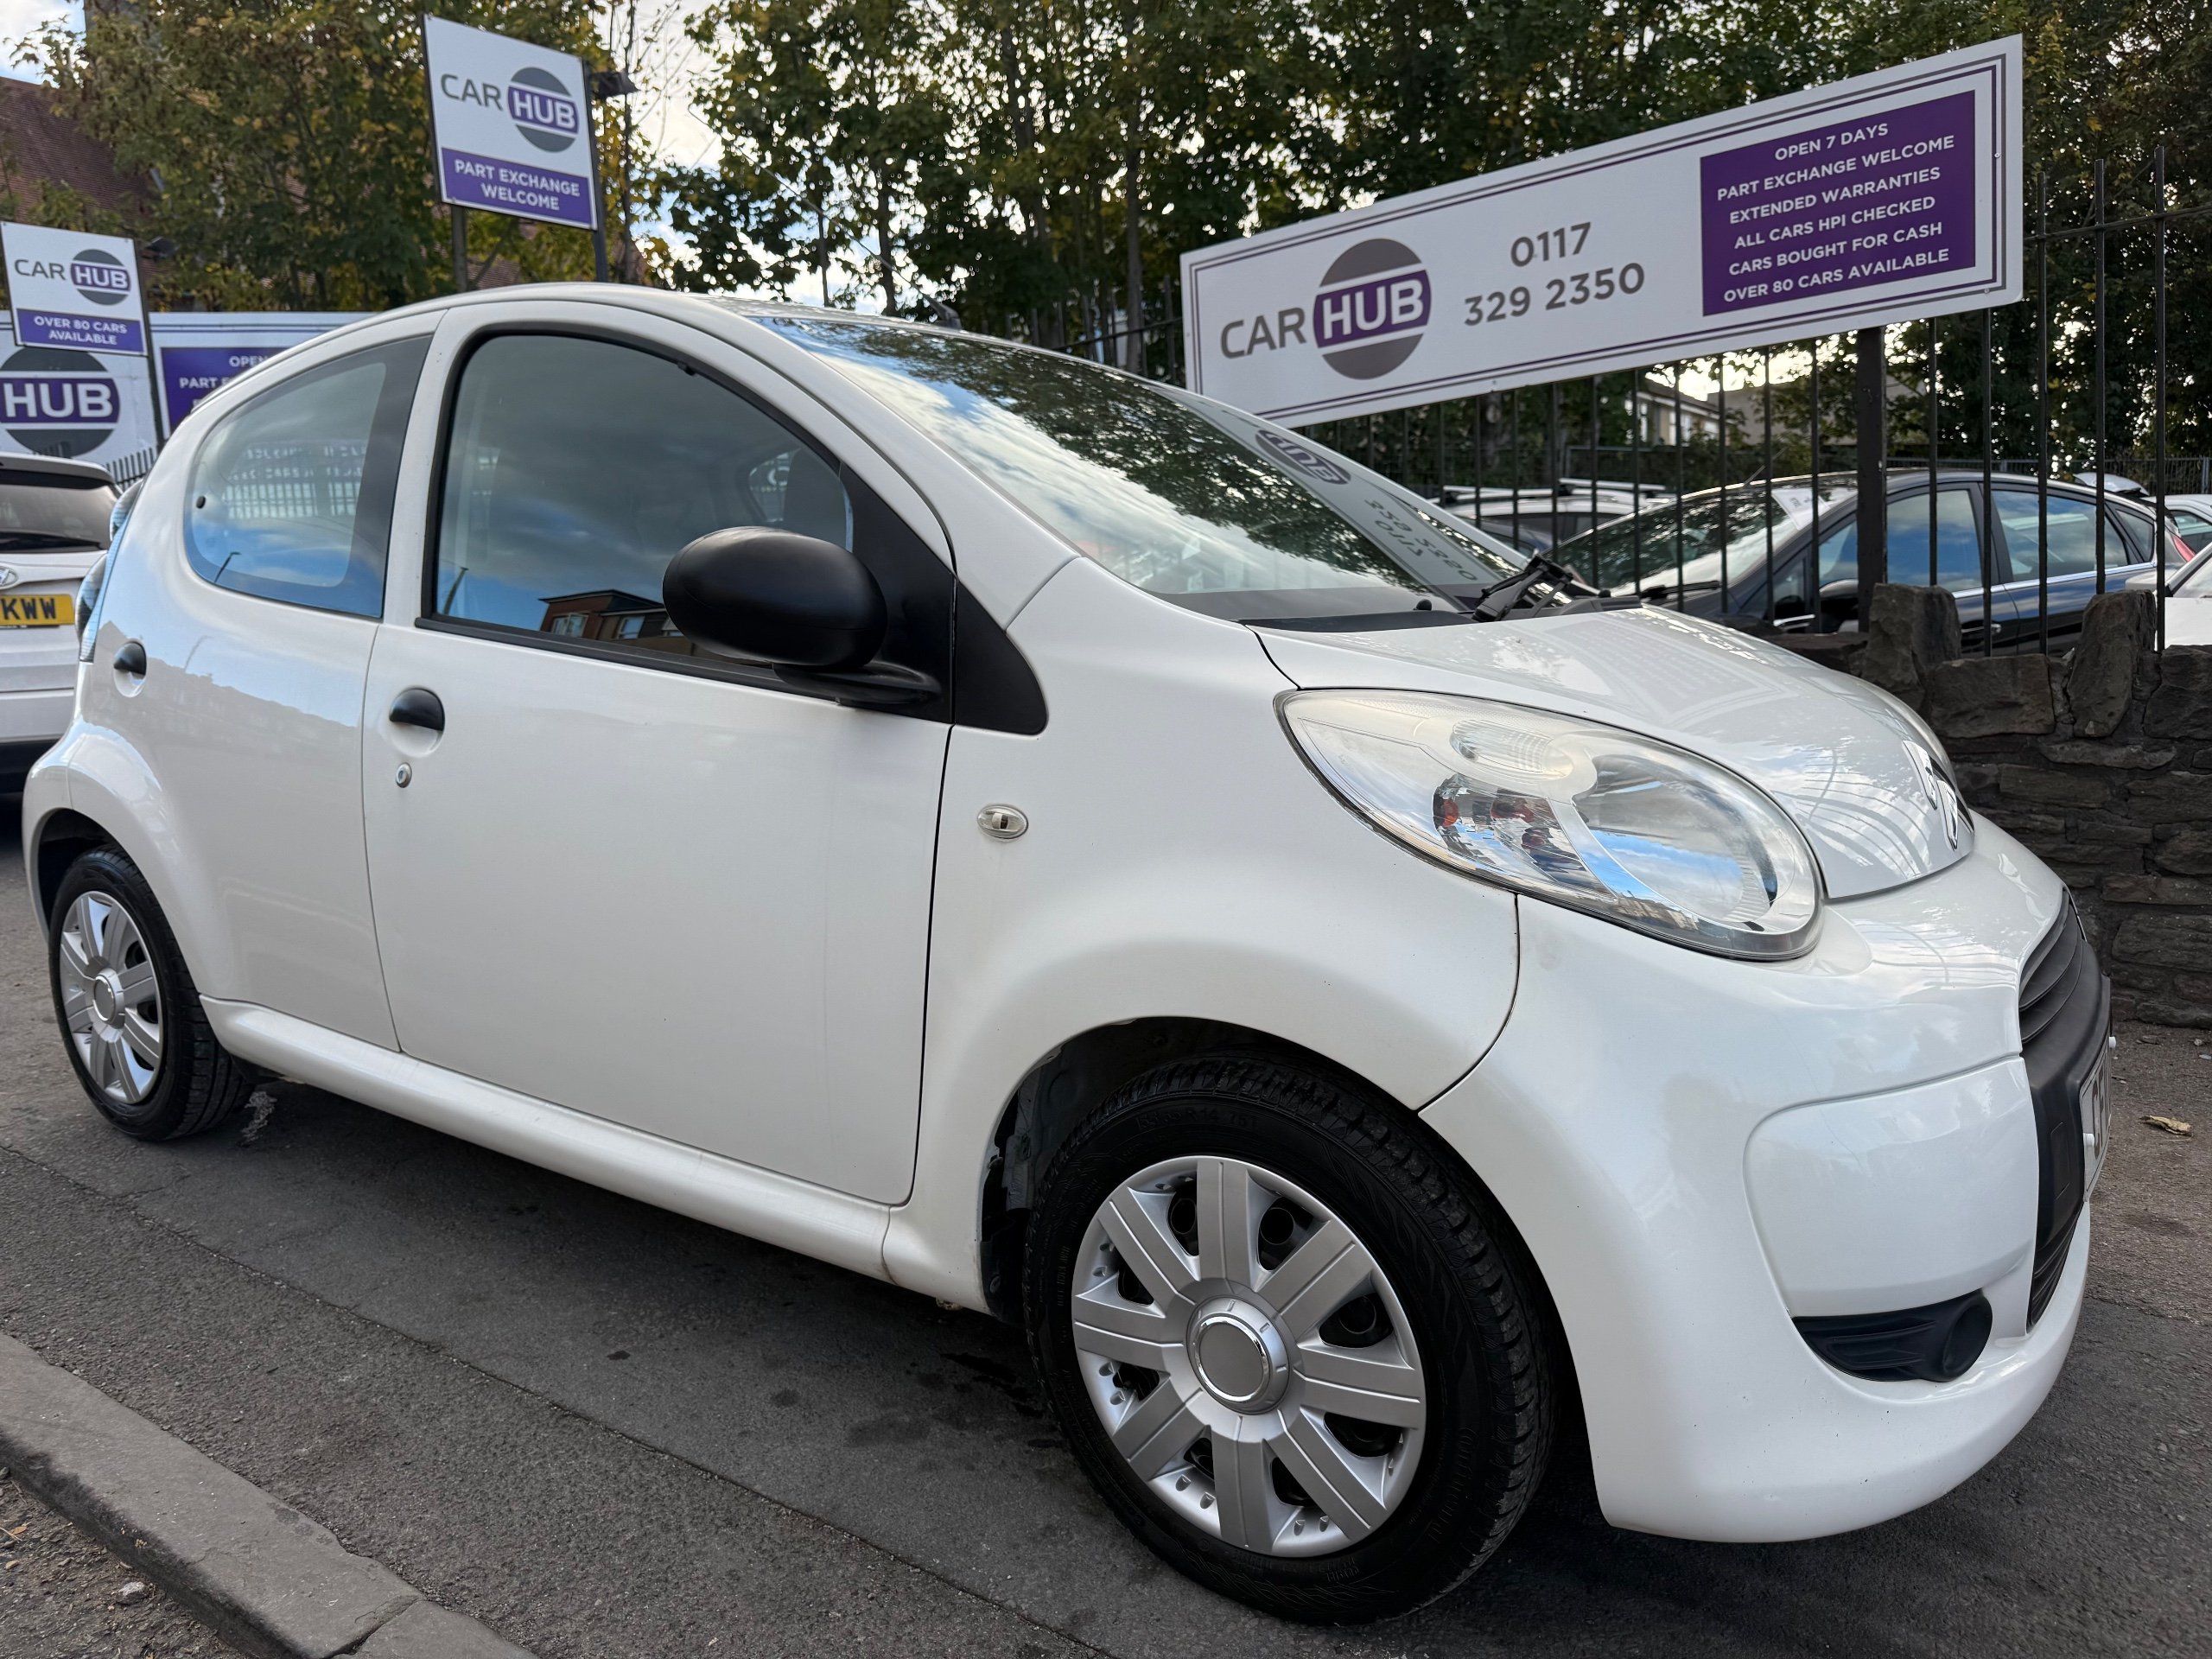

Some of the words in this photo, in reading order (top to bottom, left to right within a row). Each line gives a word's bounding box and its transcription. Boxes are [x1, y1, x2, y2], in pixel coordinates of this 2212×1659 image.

[441, 73, 504, 111] CAR
[513, 91, 575, 130] HUB
[1775, 139, 1821, 161] OPEN
[1826, 136, 1836, 149] 7
[1841, 123, 1889, 145] DAYS
[454, 159, 495, 180] PART
[499, 168, 581, 197] EXCHANGE
[1717, 181, 1759, 200] PART
[1764, 158, 1857, 191] EXCHANGE
[1861, 135, 1955, 168] WELCOME
[480, 183, 560, 211] WELCOME
[1730, 194, 1817, 225] EXTENDED
[1821, 167, 1941, 204] WARRANTIES
[1734, 232, 1765, 249] ALL
[1769, 221, 1814, 242] CARS
[1818, 214, 1846, 232] HPI
[1851, 196, 1936, 225] CHECKED
[1510, 222, 1592, 268] 0117
[1729, 257, 1772, 276] CARS
[1777, 241, 1847, 266] BOUGHT
[1852, 232, 1888, 251] FOR
[1892, 221, 1942, 243] CASH
[15, 259, 67, 280] CAR
[74, 266, 128, 289] HUB
[1464, 286, 1531, 327] 329
[1544, 262, 1645, 311] 2350
[1724, 282, 1769, 302] OVER
[1772, 279, 1794, 294] 80
[1798, 269, 1844, 289] CARS
[1848, 248, 1949, 279] AVAILABLE
[34, 315, 72, 330] OVER
[73, 320, 90, 331] 80
[92, 321, 127, 334] CARS
[49, 330, 118, 345] AVAILABLE
[1220, 307, 1307, 359] CAR
[1322, 277, 1426, 340] HUB
[3, 383, 113, 417] HUB
[179, 377, 218, 389] PART
[1, 598, 57, 620] KWW
